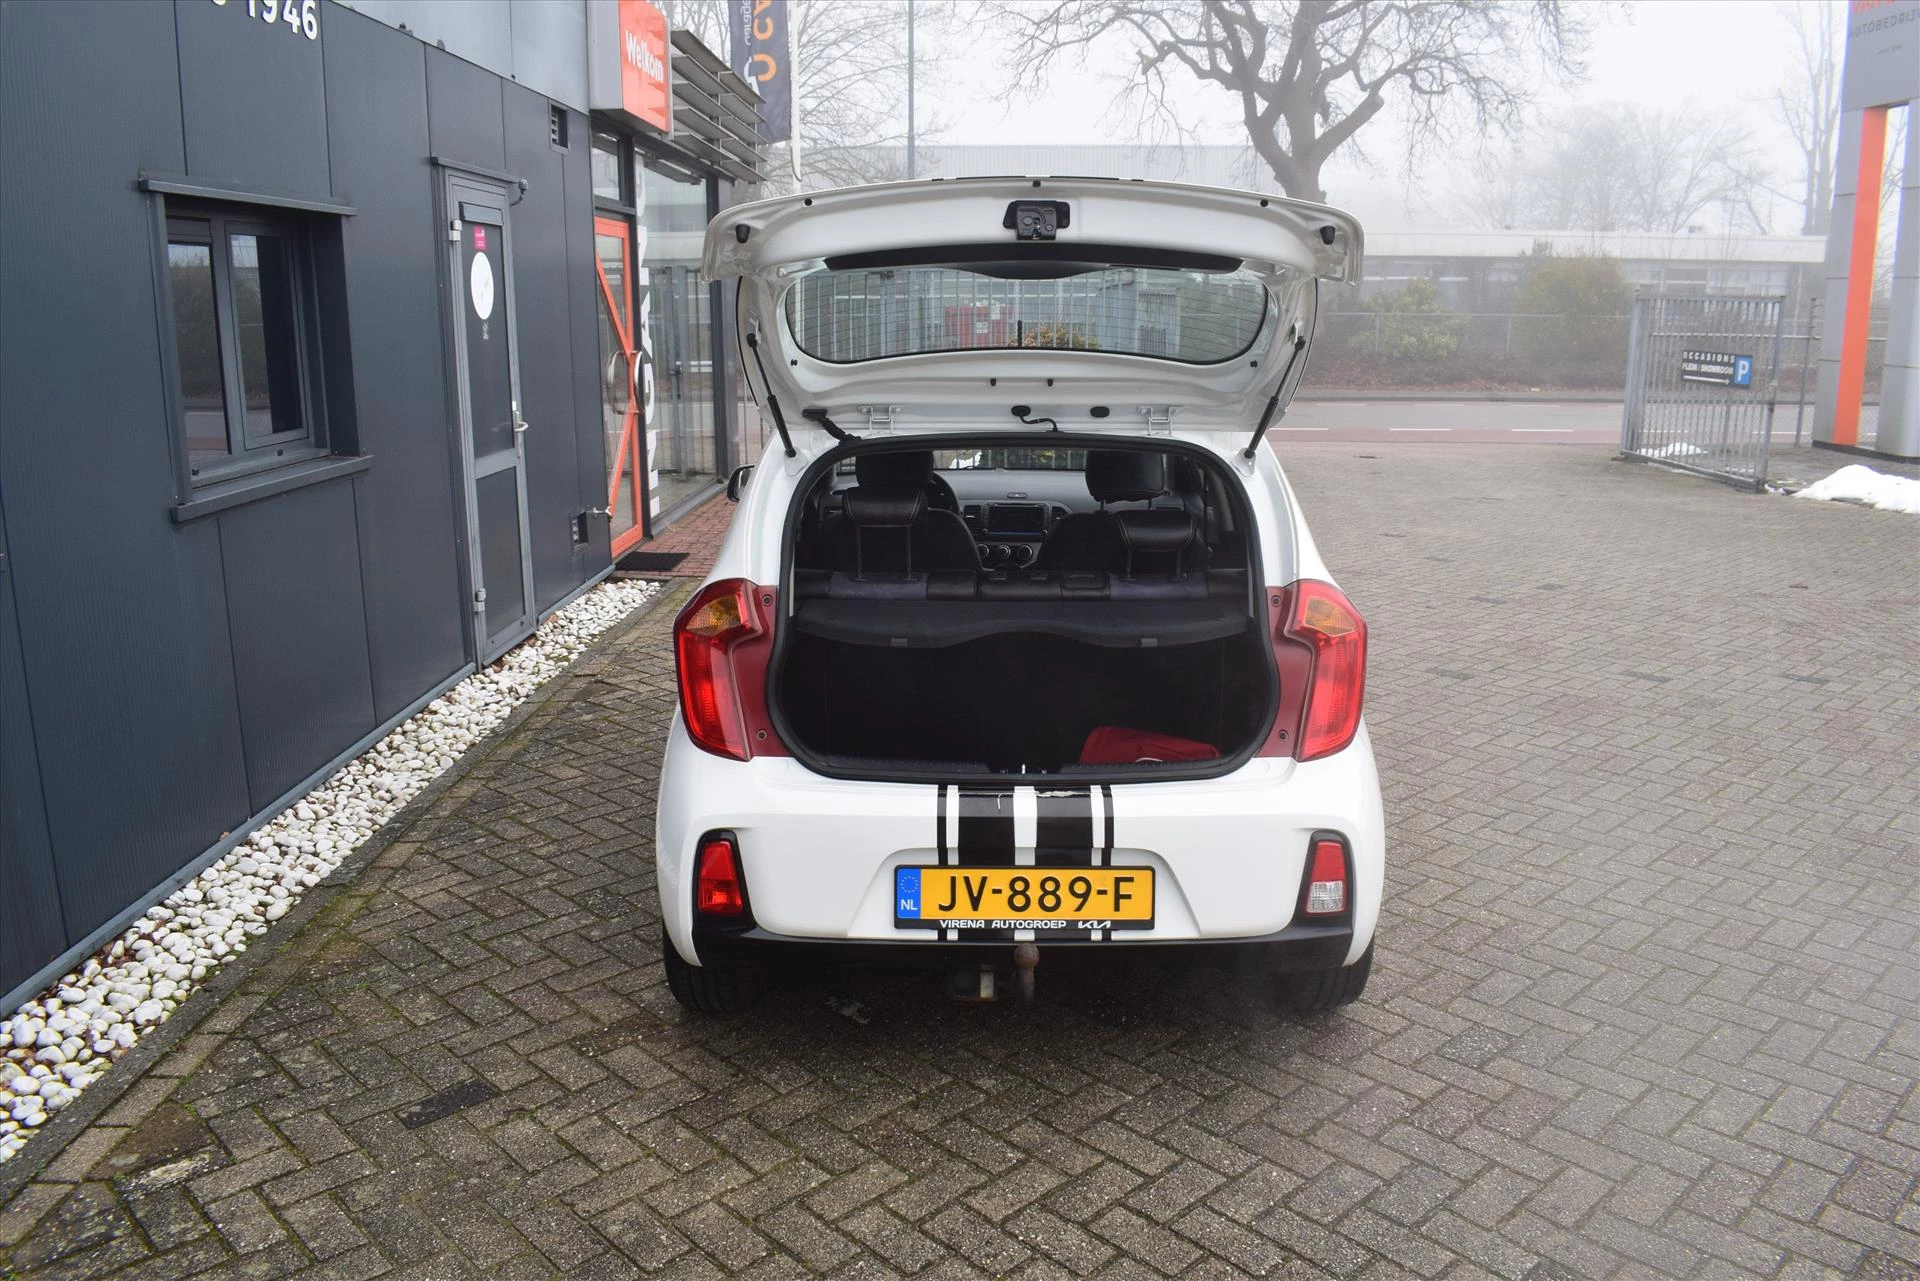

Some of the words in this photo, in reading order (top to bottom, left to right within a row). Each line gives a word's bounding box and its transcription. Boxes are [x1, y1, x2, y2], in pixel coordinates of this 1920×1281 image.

[625, 30, 664, 83] Welkom
[1682, 351, 1736, 364] OCCASIONS
[1737, 360, 1750, 382] P
[938, 875, 1135, 913] JV-889-F
[900, 898, 919, 911] NL
[939, 919, 985, 929] VIRENA
[991, 919, 1067, 929] AUTOGROEP
